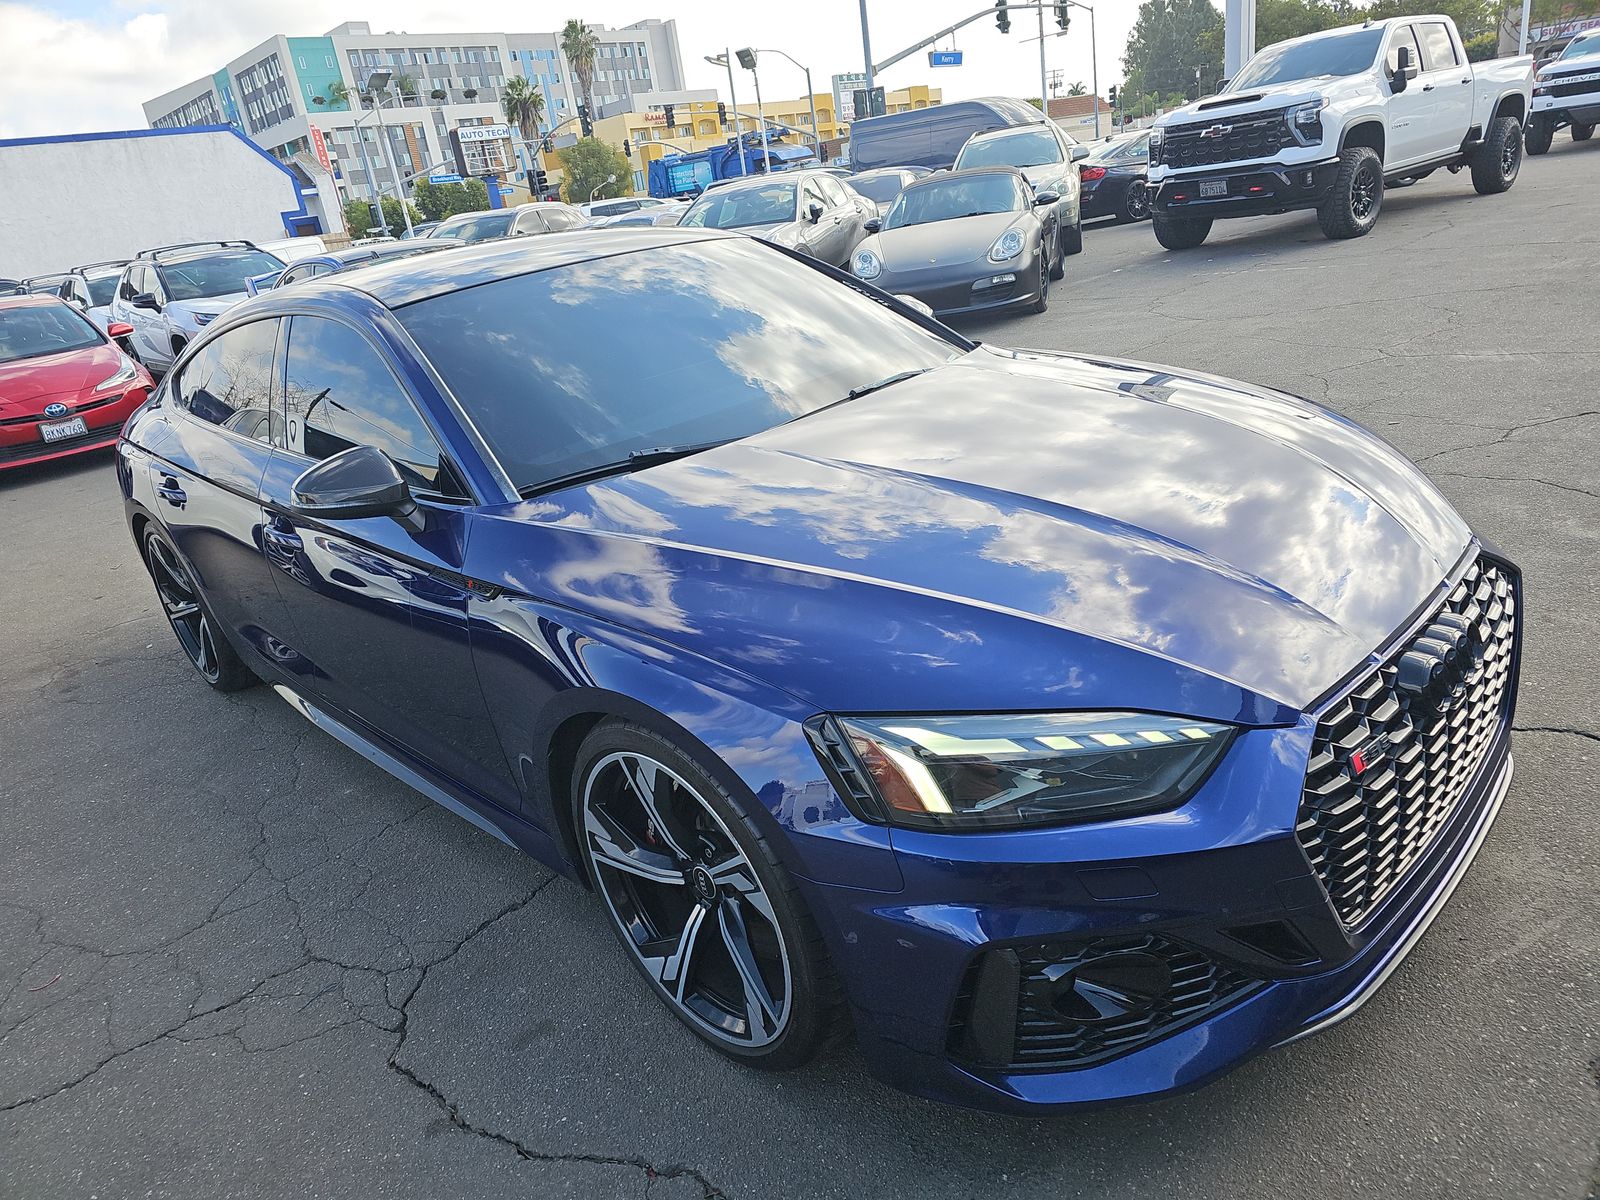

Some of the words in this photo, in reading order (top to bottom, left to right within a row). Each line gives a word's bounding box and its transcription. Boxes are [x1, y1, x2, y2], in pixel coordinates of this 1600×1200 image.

[941, 55, 955, 64] Kerry
[1553, 73, 1600, 85] CHEVR
[460, 130, 484, 140] AUTO
[484, 128, 509, 137] TECH
[45, 423, 84, 440] 8KNK768
